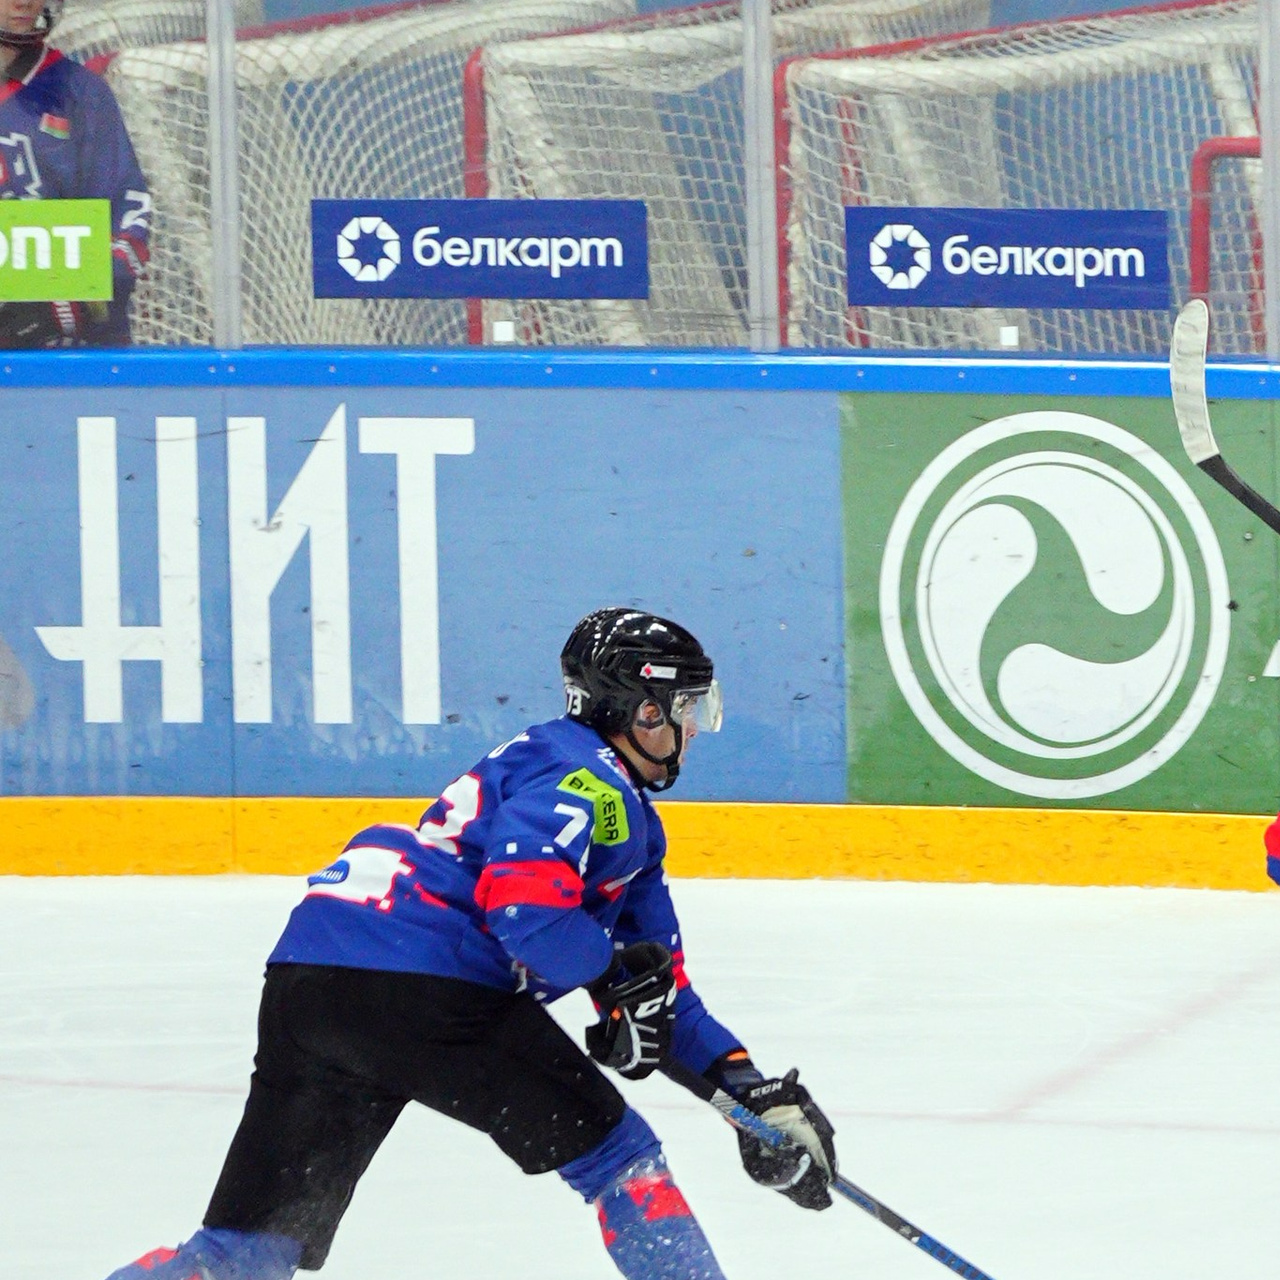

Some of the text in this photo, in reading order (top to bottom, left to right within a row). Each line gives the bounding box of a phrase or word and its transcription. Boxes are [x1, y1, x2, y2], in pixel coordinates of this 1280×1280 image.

[413, 225, 623, 277] белкарт
[943, 234, 1145, 287] белкарт
[751, 1080, 783, 1098] CCM
